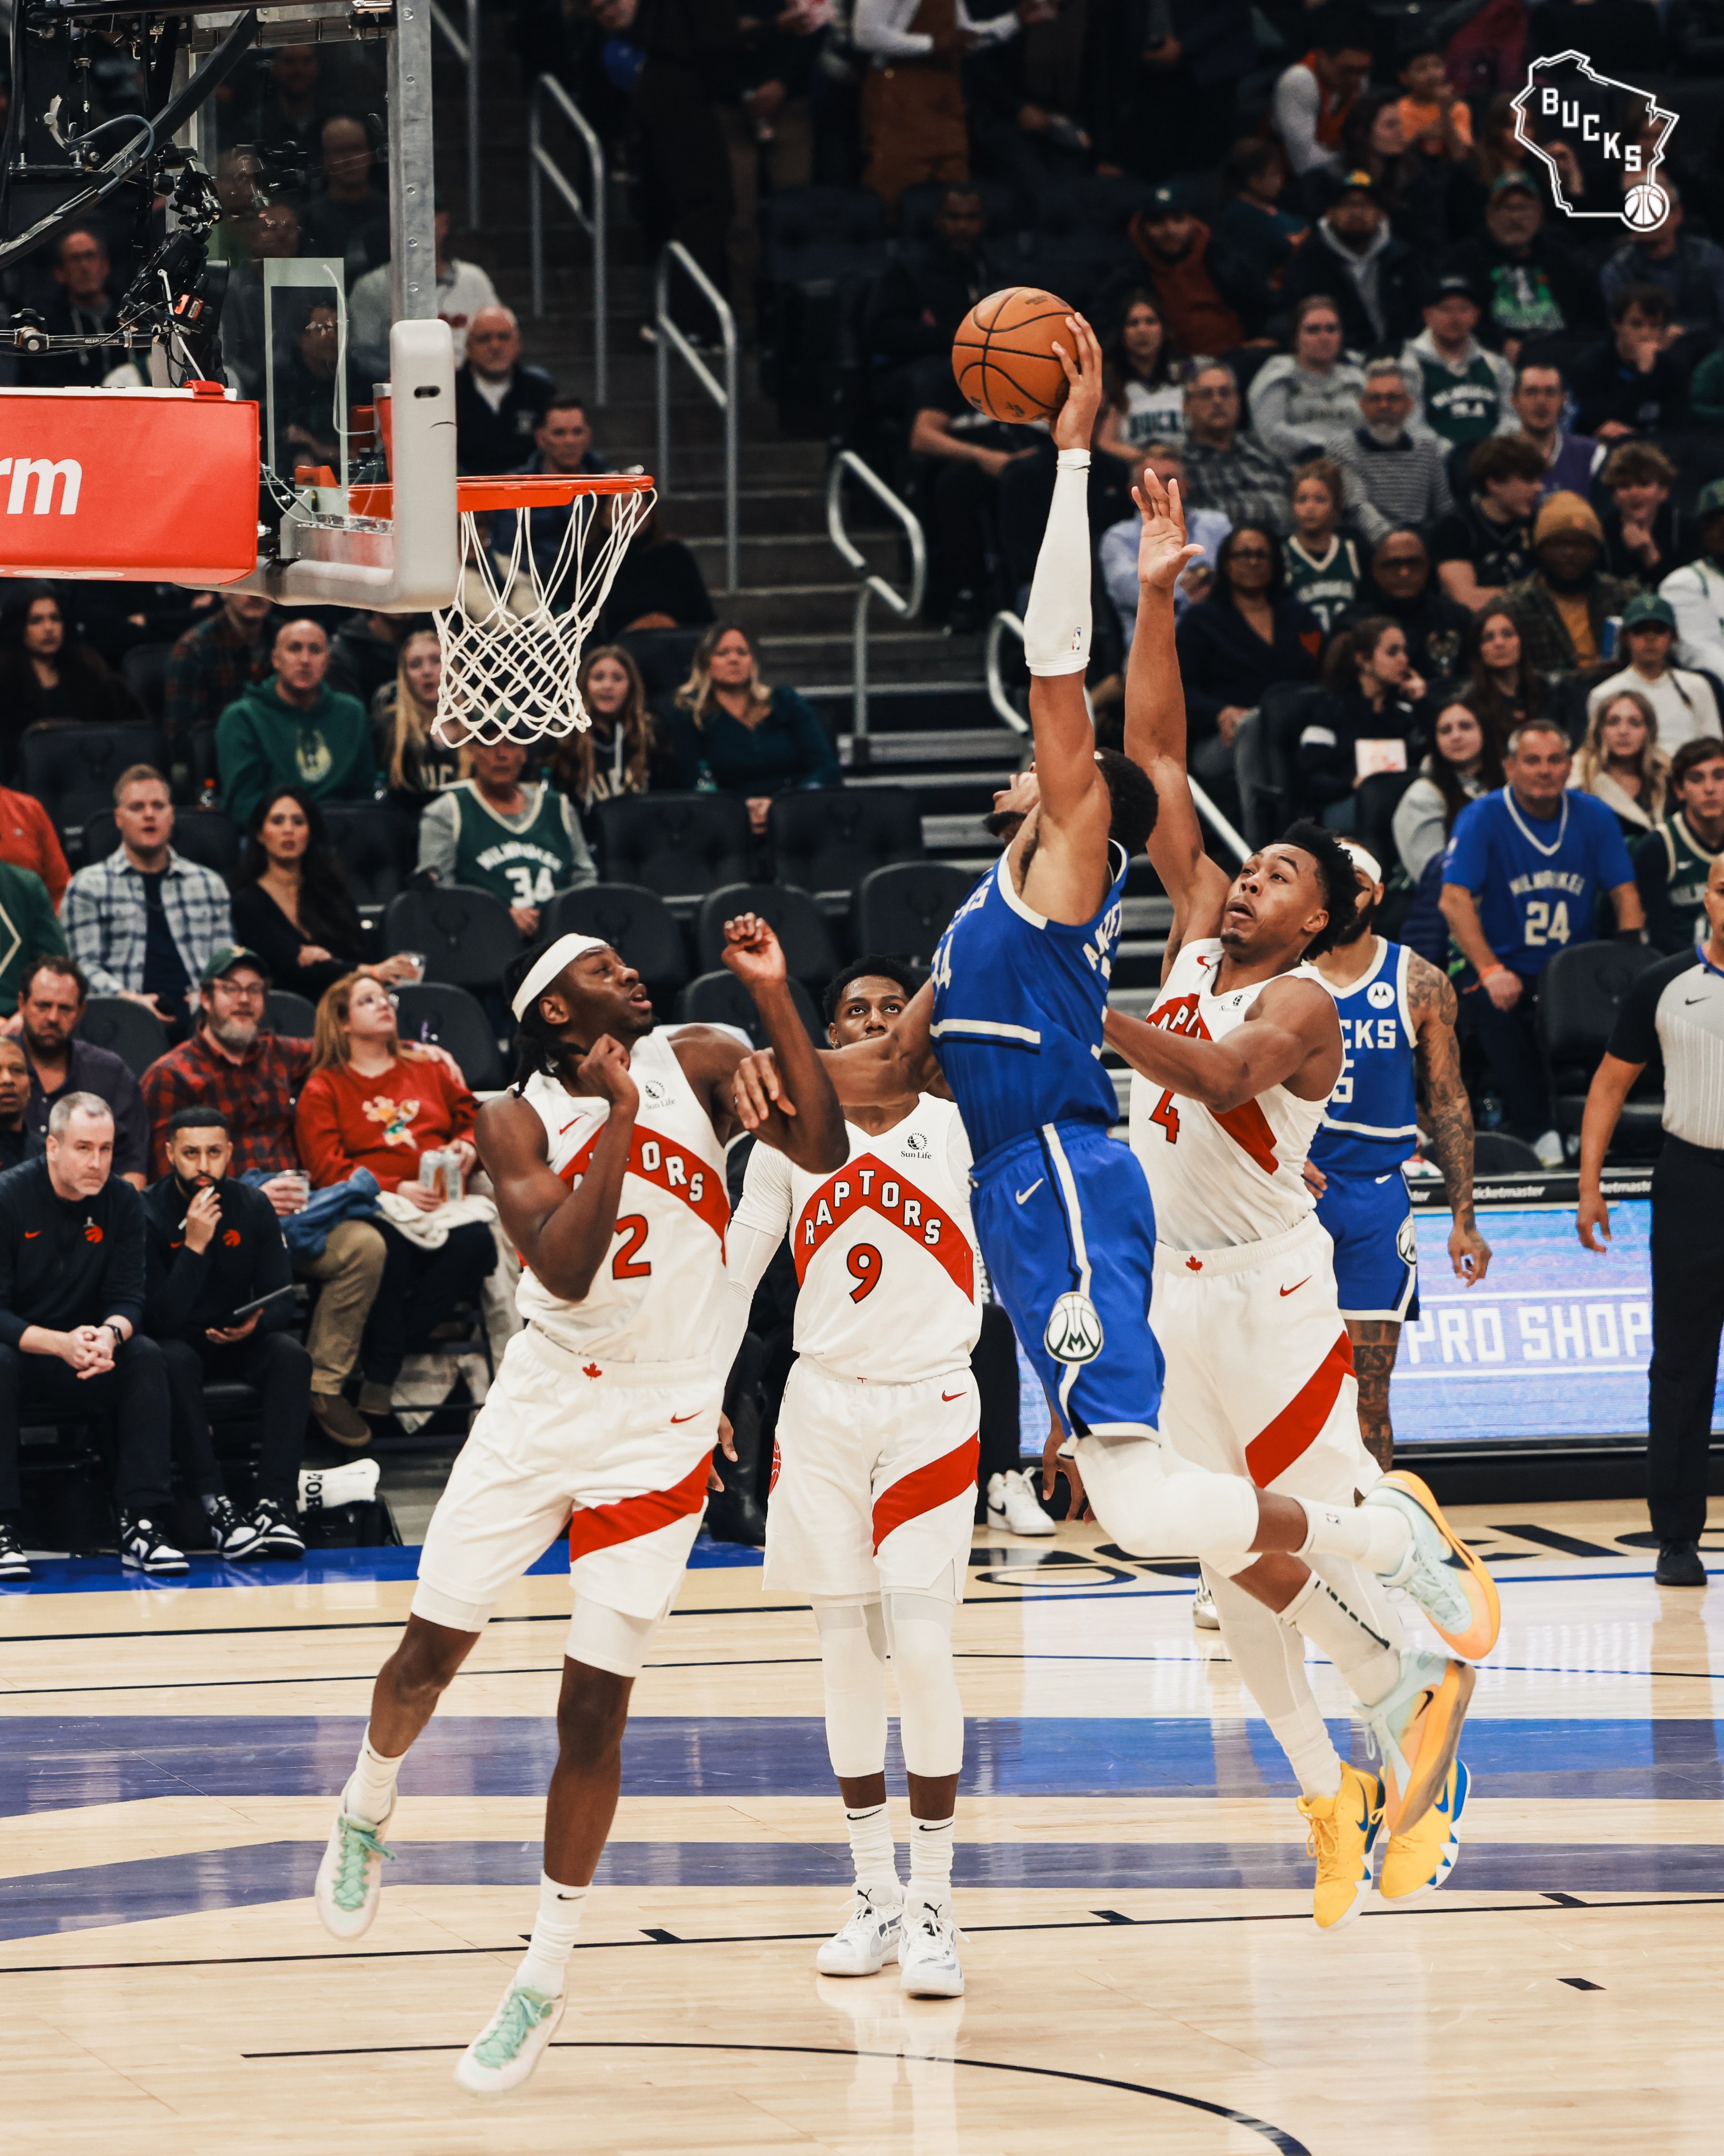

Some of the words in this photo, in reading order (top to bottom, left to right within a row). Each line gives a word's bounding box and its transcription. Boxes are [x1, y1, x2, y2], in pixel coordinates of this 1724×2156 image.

[1525, 902, 1571, 946] 24
[1151, 1004, 1202, 1039] APT
[1148, 1087, 1180, 1145] 4
[805, 1169, 942, 1245] RAPTORS
[612, 1214, 651, 1280] 2
[846, 1243, 883, 1305] 9
[1406, 1307, 1506, 1364] PRO
[1518, 1301, 1652, 1360] SHOP
